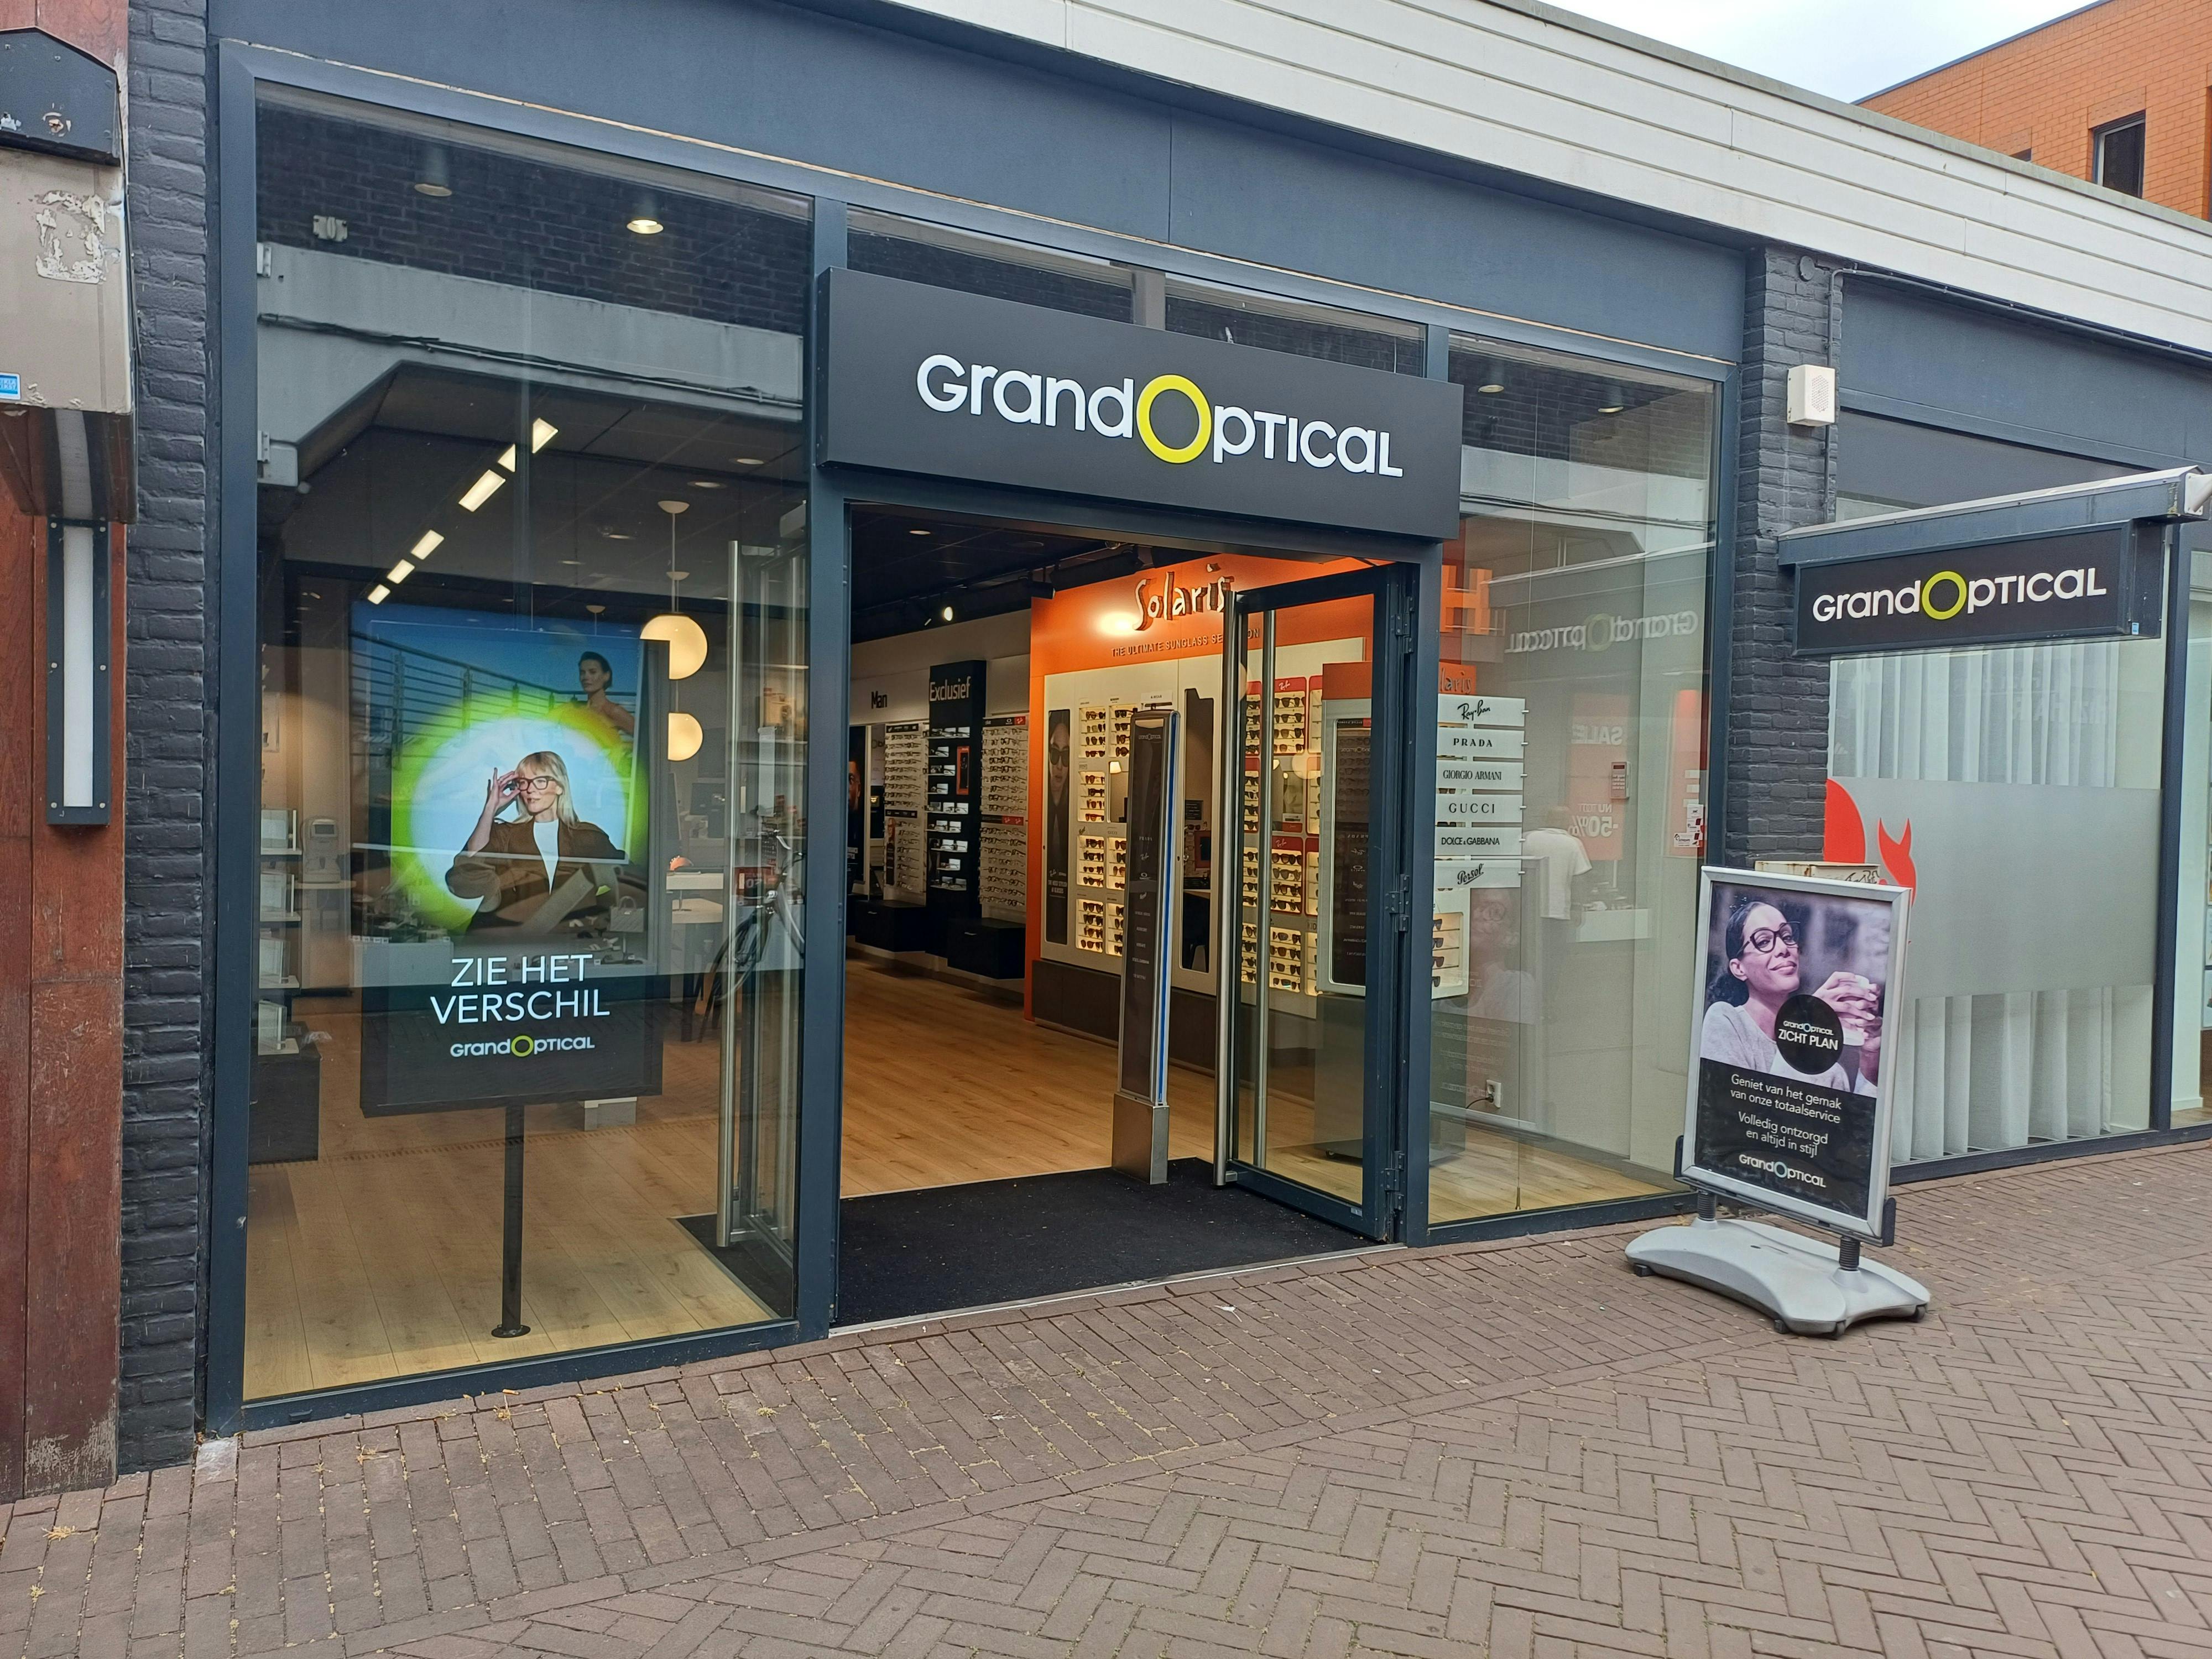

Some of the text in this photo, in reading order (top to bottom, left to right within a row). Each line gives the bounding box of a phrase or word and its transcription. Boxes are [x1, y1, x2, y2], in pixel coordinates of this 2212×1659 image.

[916, 354, 1404, 477] GrandOptical
[1133, 562, 1234, 630] Solaris
[1812, 567, 2106, 622] GrandOptical
[1111, 647, 1126, 657] THE
[1127, 642, 1164, 655] ULTIMATE
[1166, 635, 1208, 650] SUNGLASS
[929, 676, 972, 702] Exclusief
[1439, 667, 1472, 694] laris
[871, 691, 888, 709] Man
[1453, 738, 1493, 747] PRADA
[1443, 770, 1502, 780] GIORGIO ARMANI
[1449, 803, 1495, 813] GUCCI
[1457, 863, 1484, 885] Persol
[451, 954, 593, 987] ZIE HET
[430, 989, 610, 1024] VERSCHIL
[450, 1035, 595, 1057] GrandOptical
[1778, 1029, 1839, 1051] ZICHT PLAN
[1731, 1073, 1842, 1110] Geniet van het gemak
[1730, 1089, 1840, 1124] van onze totaalservice
[1738, 1112, 1828, 1145] Volledig ontzorgd
[1746, 1129, 1818, 1157] en altijd in stijl
[1739, 1154, 1827, 1188] GrandOptical
